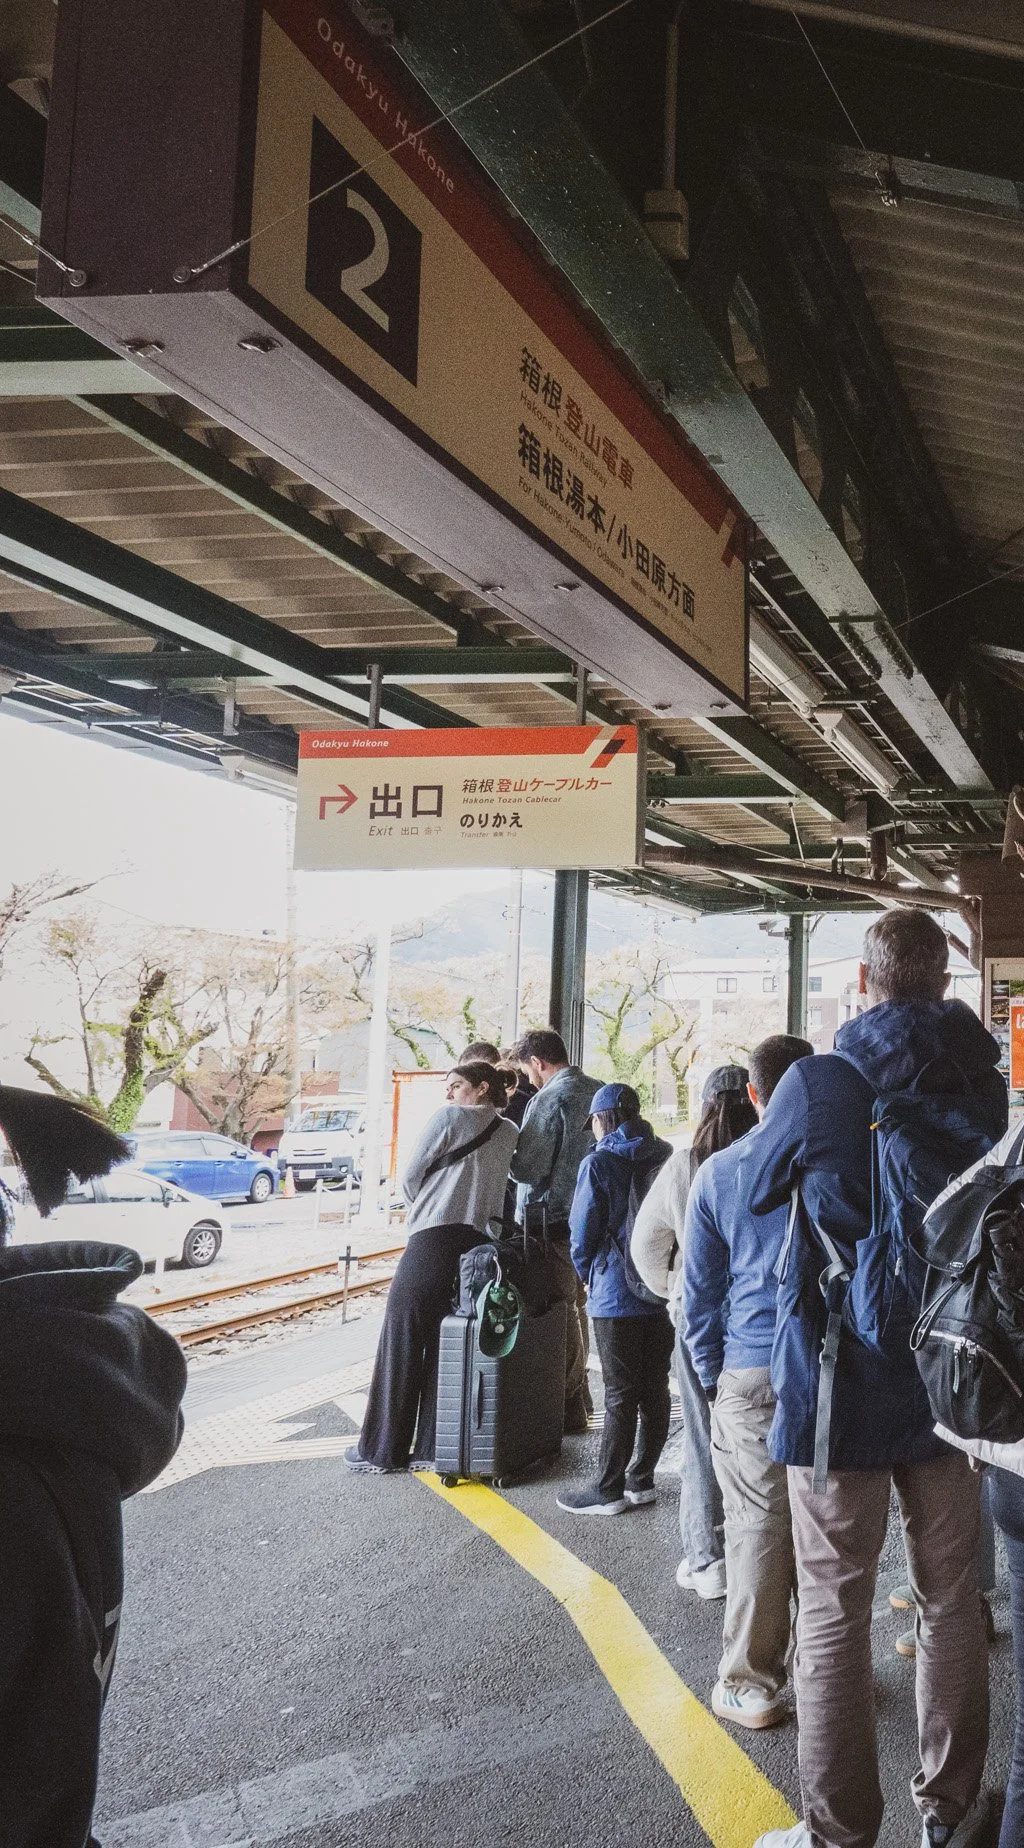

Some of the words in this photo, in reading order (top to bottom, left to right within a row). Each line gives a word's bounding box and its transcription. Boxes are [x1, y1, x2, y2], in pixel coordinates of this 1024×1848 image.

[316, 17, 388, 114] Odakyu
[395, 111, 455, 194] Hakone
[340, 187, 390, 333] 2
[519, 347, 635, 491] 箱根登山電車
[520, 390, 553, 432] Hakone
[554, 427, 579, 456] Tozan
[579, 450, 608, 490] Railway
[518, 474, 532, 496] For
[312, 739, 349, 749] Odakyu
[352, 738, 389, 748] Hakone
[461, 777, 612, 794] 箱根登山ケーブルカー
[369, 783, 443, 820] 出口
[462, 796, 494, 804] Hakone
[498, 796, 523, 804] Tozan
[525, 795, 562, 804] Cablecar
[368, 825, 394, 837] Exit
[400, 826, 419, 836] 出口
[459, 812, 523, 829] のりかえ
